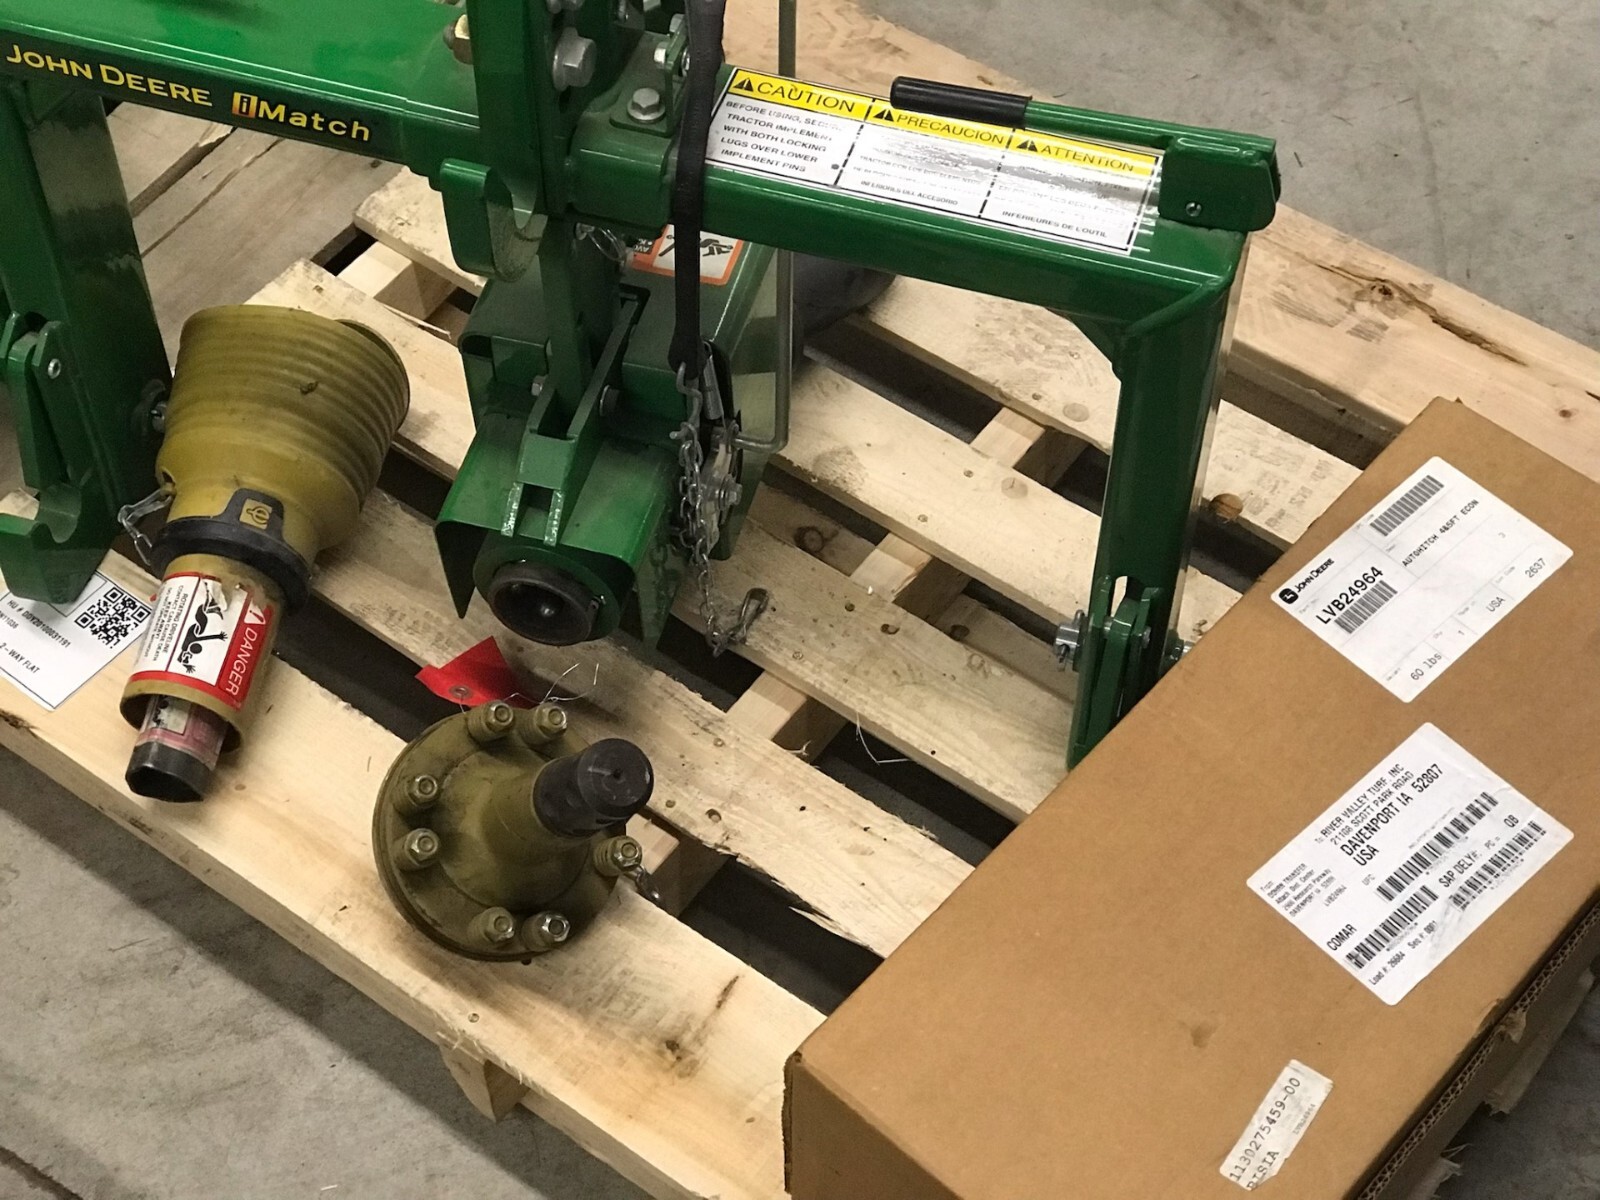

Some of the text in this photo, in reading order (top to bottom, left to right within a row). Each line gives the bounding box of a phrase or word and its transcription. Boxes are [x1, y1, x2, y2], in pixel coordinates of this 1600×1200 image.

[6, 44, 212, 107] JOHN DEERE
[725, 100, 766, 115] BEFORE
[757, 81, 856, 113] CAUTION
[231, 91, 371, 141] iMatch
[727, 112, 774, 129] TRACTOR
[720, 136, 818, 163] LUGS OVER LOWER
[723, 124, 826, 152] WITH BOTH LOCKING
[720, 148, 806, 172] IMPLEMENT PINS
[1042, 144, 1135, 173] ATTENTION
[1401, 533, 1439, 567] AUTOHITCH
[1460, 498, 1479, 516] ECON
[1294, 557, 1335, 593] JOHN DEERE
[1524, 557, 1546, 579] 2637
[173, 593, 189, 622] ROTATING
[1315, 565, 1384, 625] LVB24964
[1486, 595, 1506, 613] USA
[22, 659, 40, 674] FLAT
[225, 627, 259, 697] DANGER
[1409, 667, 1425, 681] 60
[1422, 652, 1442, 669] lbs
[1320, 815, 1345, 838] RIVER
[1341, 792, 1370, 819] VALLEY
[1387, 763, 1405, 778] INC
[1339, 801, 1401, 857] DAVENPORT
[1395, 791, 1414, 807] IA
[1410, 762, 1444, 794] 52807
[1350, 804, 1375, 828] SCOTT
[1372, 787, 1395, 808] PARK
[1391, 770, 1414, 791] ROAD
[1352, 843, 1380, 867] USA
[1438, 869, 1457, 888] SAP
[1326, 922, 1357, 952] COMAR
[1368, 970, 1385, 986] Load
[1229, 1077, 1301, 1181] 1130275459-00
